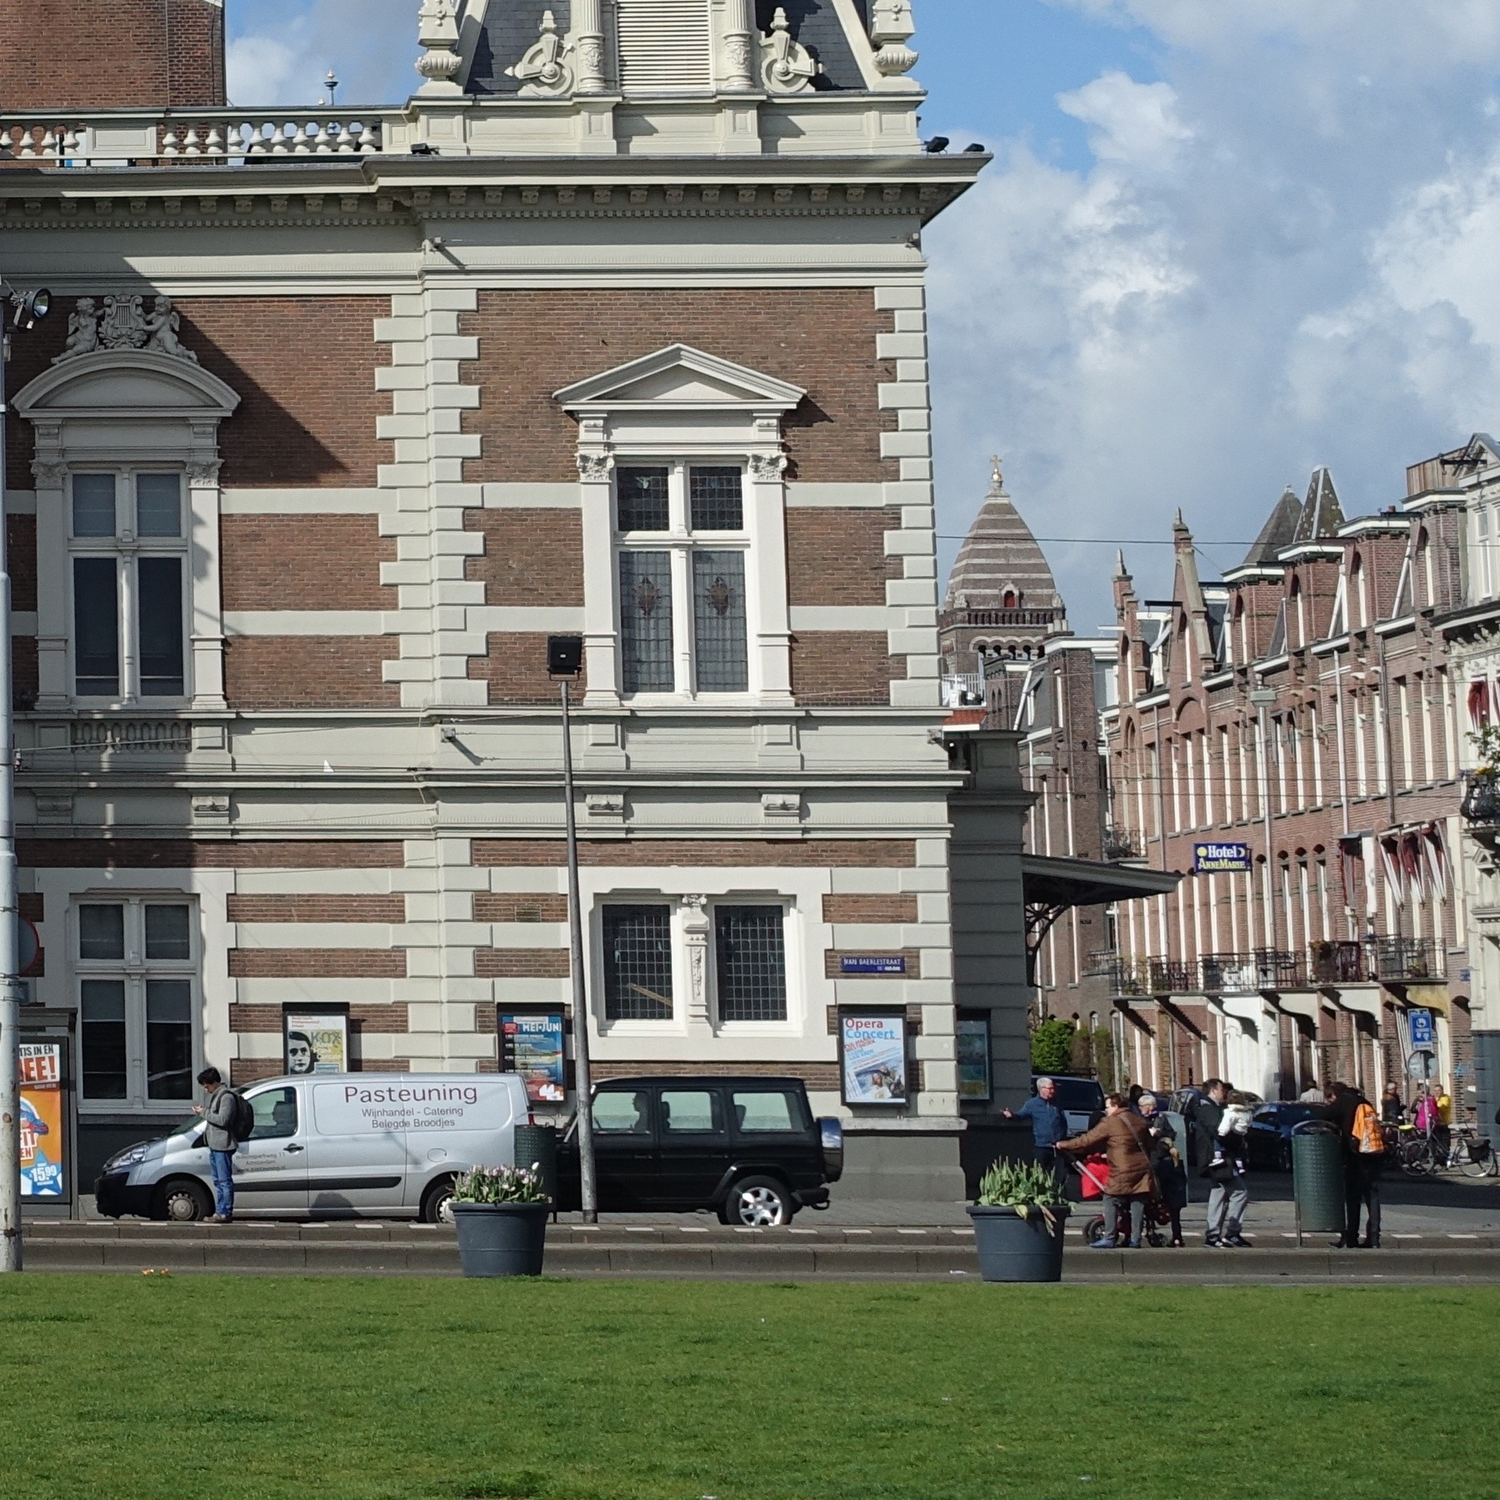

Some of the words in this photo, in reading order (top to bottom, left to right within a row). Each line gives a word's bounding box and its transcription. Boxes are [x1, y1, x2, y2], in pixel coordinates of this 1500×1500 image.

[1207, 845, 1237, 858] Hotel
[845, 1017, 883, 1030] Opera
[845, 1029, 895, 1039] Concert
[34, 1046, 42, 1055] IN
[44, 1045, 54, 1054] EN
[344, 1084, 477, 1105] Pasteuning
[362, 1108, 414, 1118] Wijnhandel
[424, 1107, 463, 1118] Catering
[372, 1119, 410, 1129] Belegde
[414, 1118, 455, 1129] Broodjes
